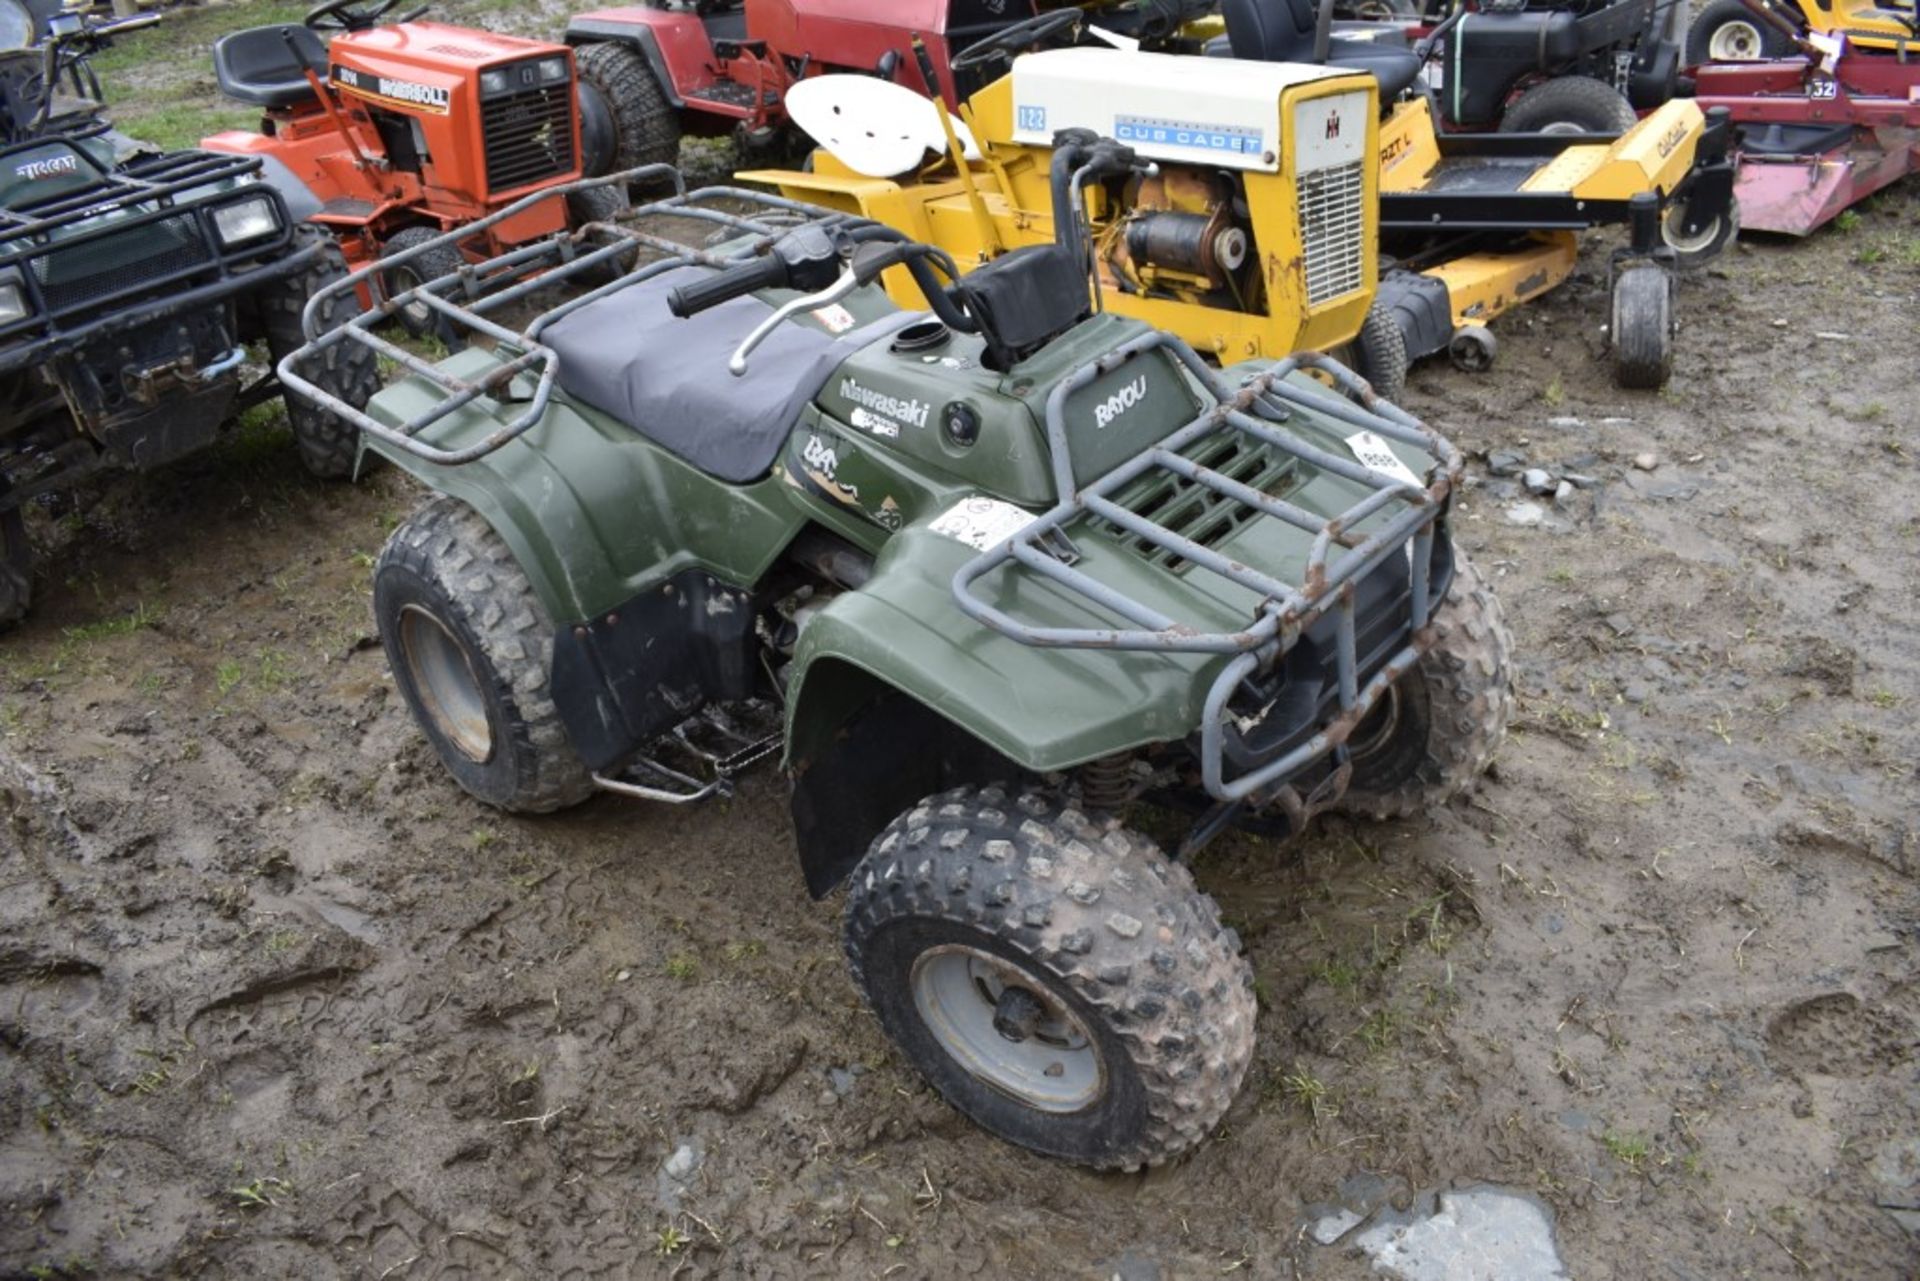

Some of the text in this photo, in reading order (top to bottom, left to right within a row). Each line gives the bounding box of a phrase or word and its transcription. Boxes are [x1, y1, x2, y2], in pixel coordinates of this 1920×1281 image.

[1019, 107, 1046, 131] 122
[1118, 126, 1260, 151] CUB CADET
[840, 377, 931, 429] Kawasaki
[1094, 374, 1147, 429] BAYOU
